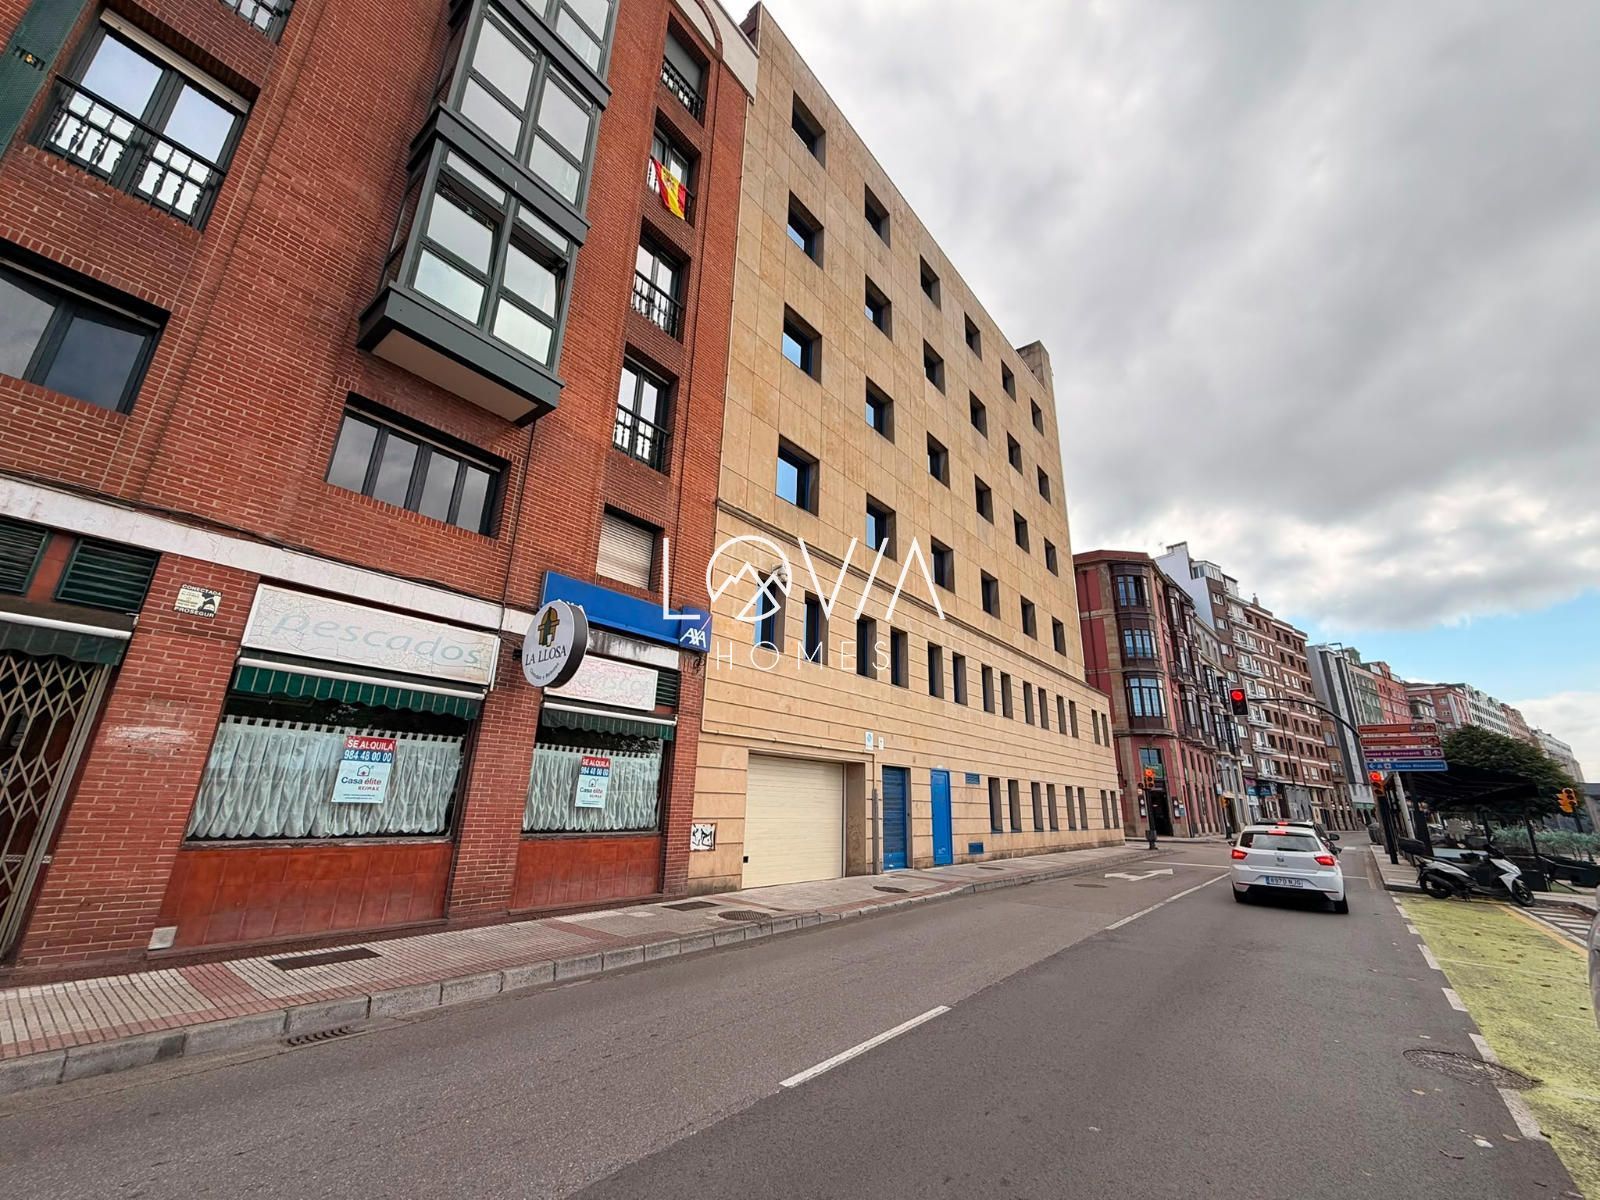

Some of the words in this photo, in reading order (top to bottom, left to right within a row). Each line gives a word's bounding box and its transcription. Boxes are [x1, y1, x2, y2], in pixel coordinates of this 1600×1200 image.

[174, 605, 214, 618] PROSEGUR
[680, 626, 708, 649] AXA
[525, 653, 535, 666] LA
[538, 645, 566, 663] LLOSA
[347, 740, 360, 748] SE
[360, 741, 394, 751] ALQUILA
[344, 750, 360, 760] 984
[360, 751, 371, 760] 48
[372, 752, 381, 761] 00
[382, 753, 392, 762] 00
[590, 760, 610, 768] ALQUILA
[341, 776, 363, 785] Casa
